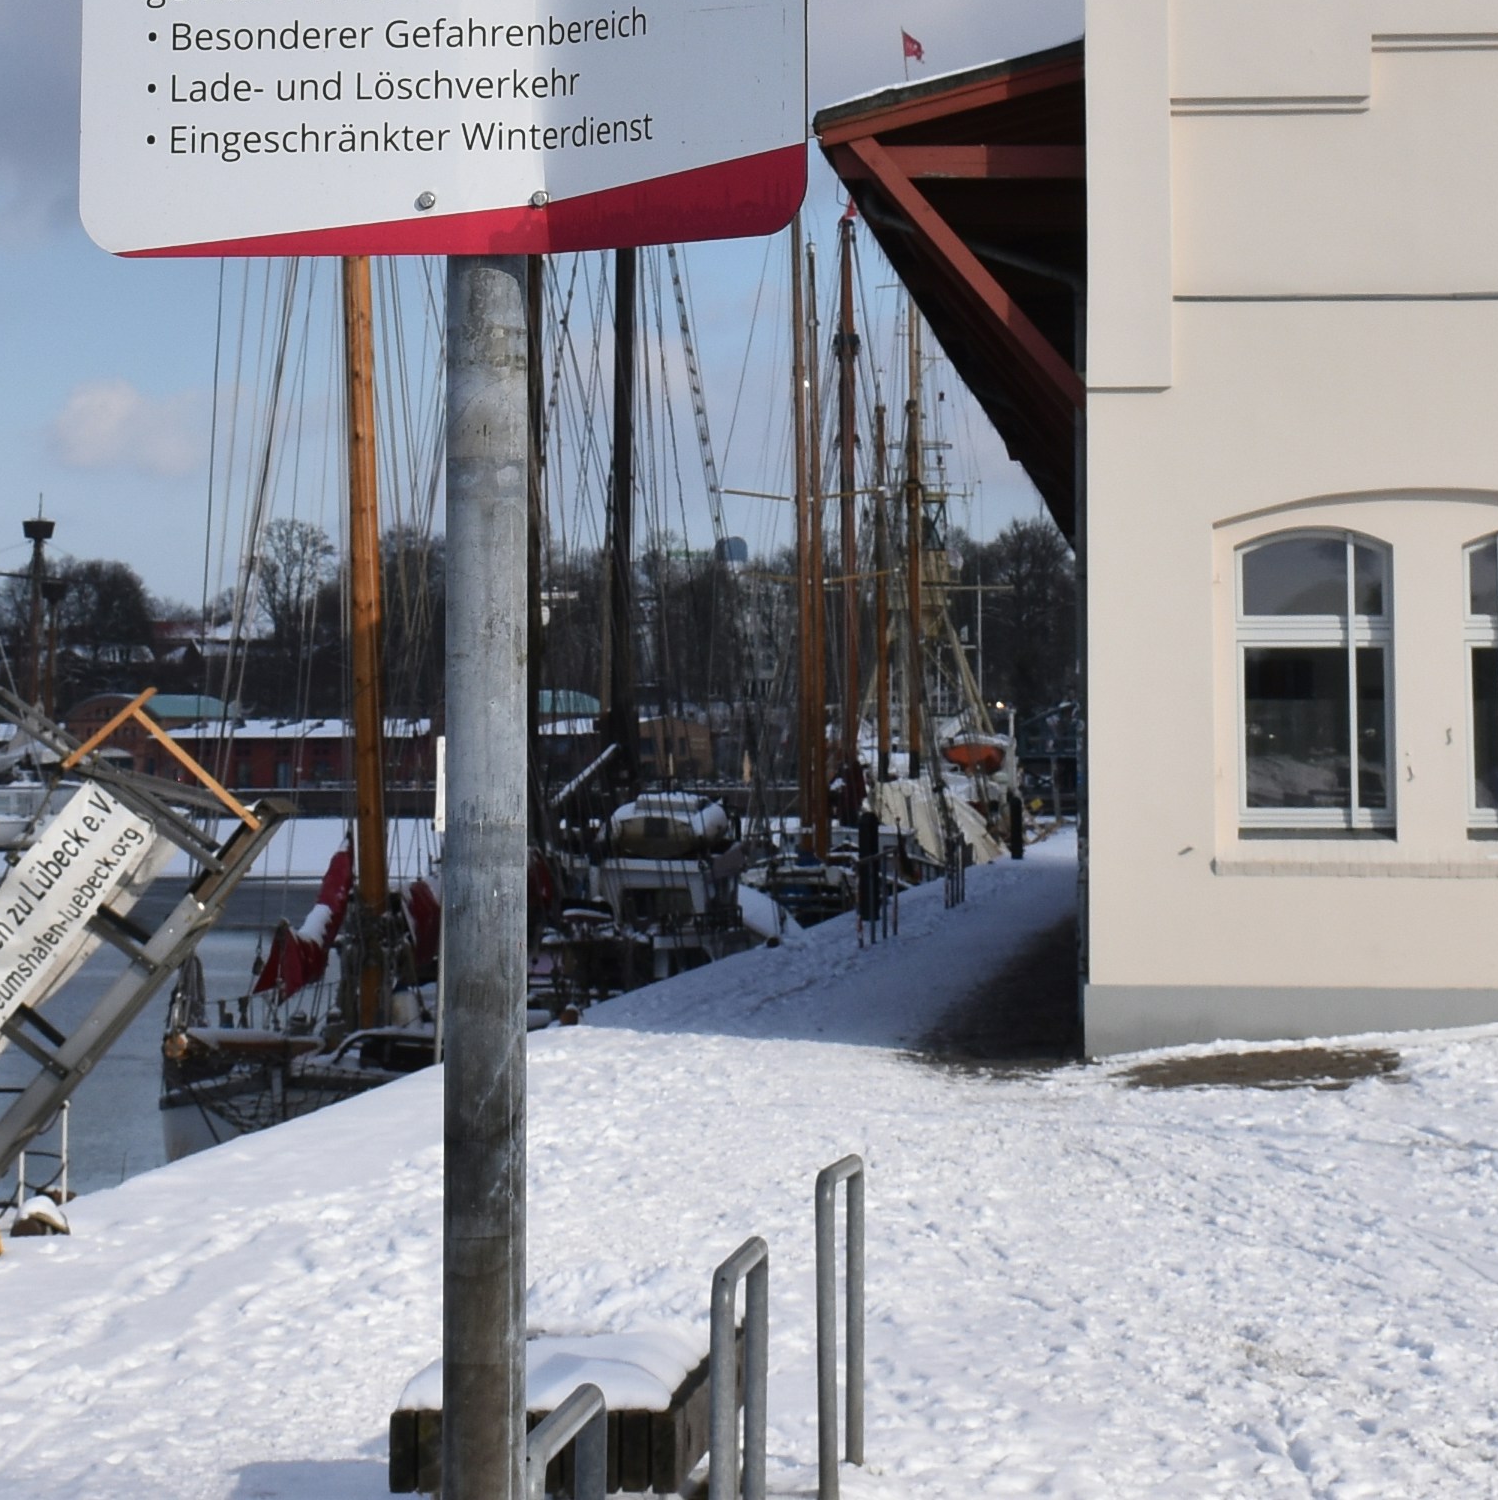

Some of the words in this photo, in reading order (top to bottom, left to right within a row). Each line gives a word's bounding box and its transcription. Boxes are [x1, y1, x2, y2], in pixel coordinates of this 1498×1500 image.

[172, 19, 374, 53] Besonderer
[385, 5, 647, 50] Gefahrenbereich
[171, 71, 264, 103] Lade-
[276, 70, 342, 102] und
[356, 67, 581, 101] Löschverkehr
[170, 121, 451, 163] Eingeschränkter
[460, 113, 653, 152] Winterdienst
[18, 827, 90, 901] Lübeck
[6, 895, 35, 927] zu
